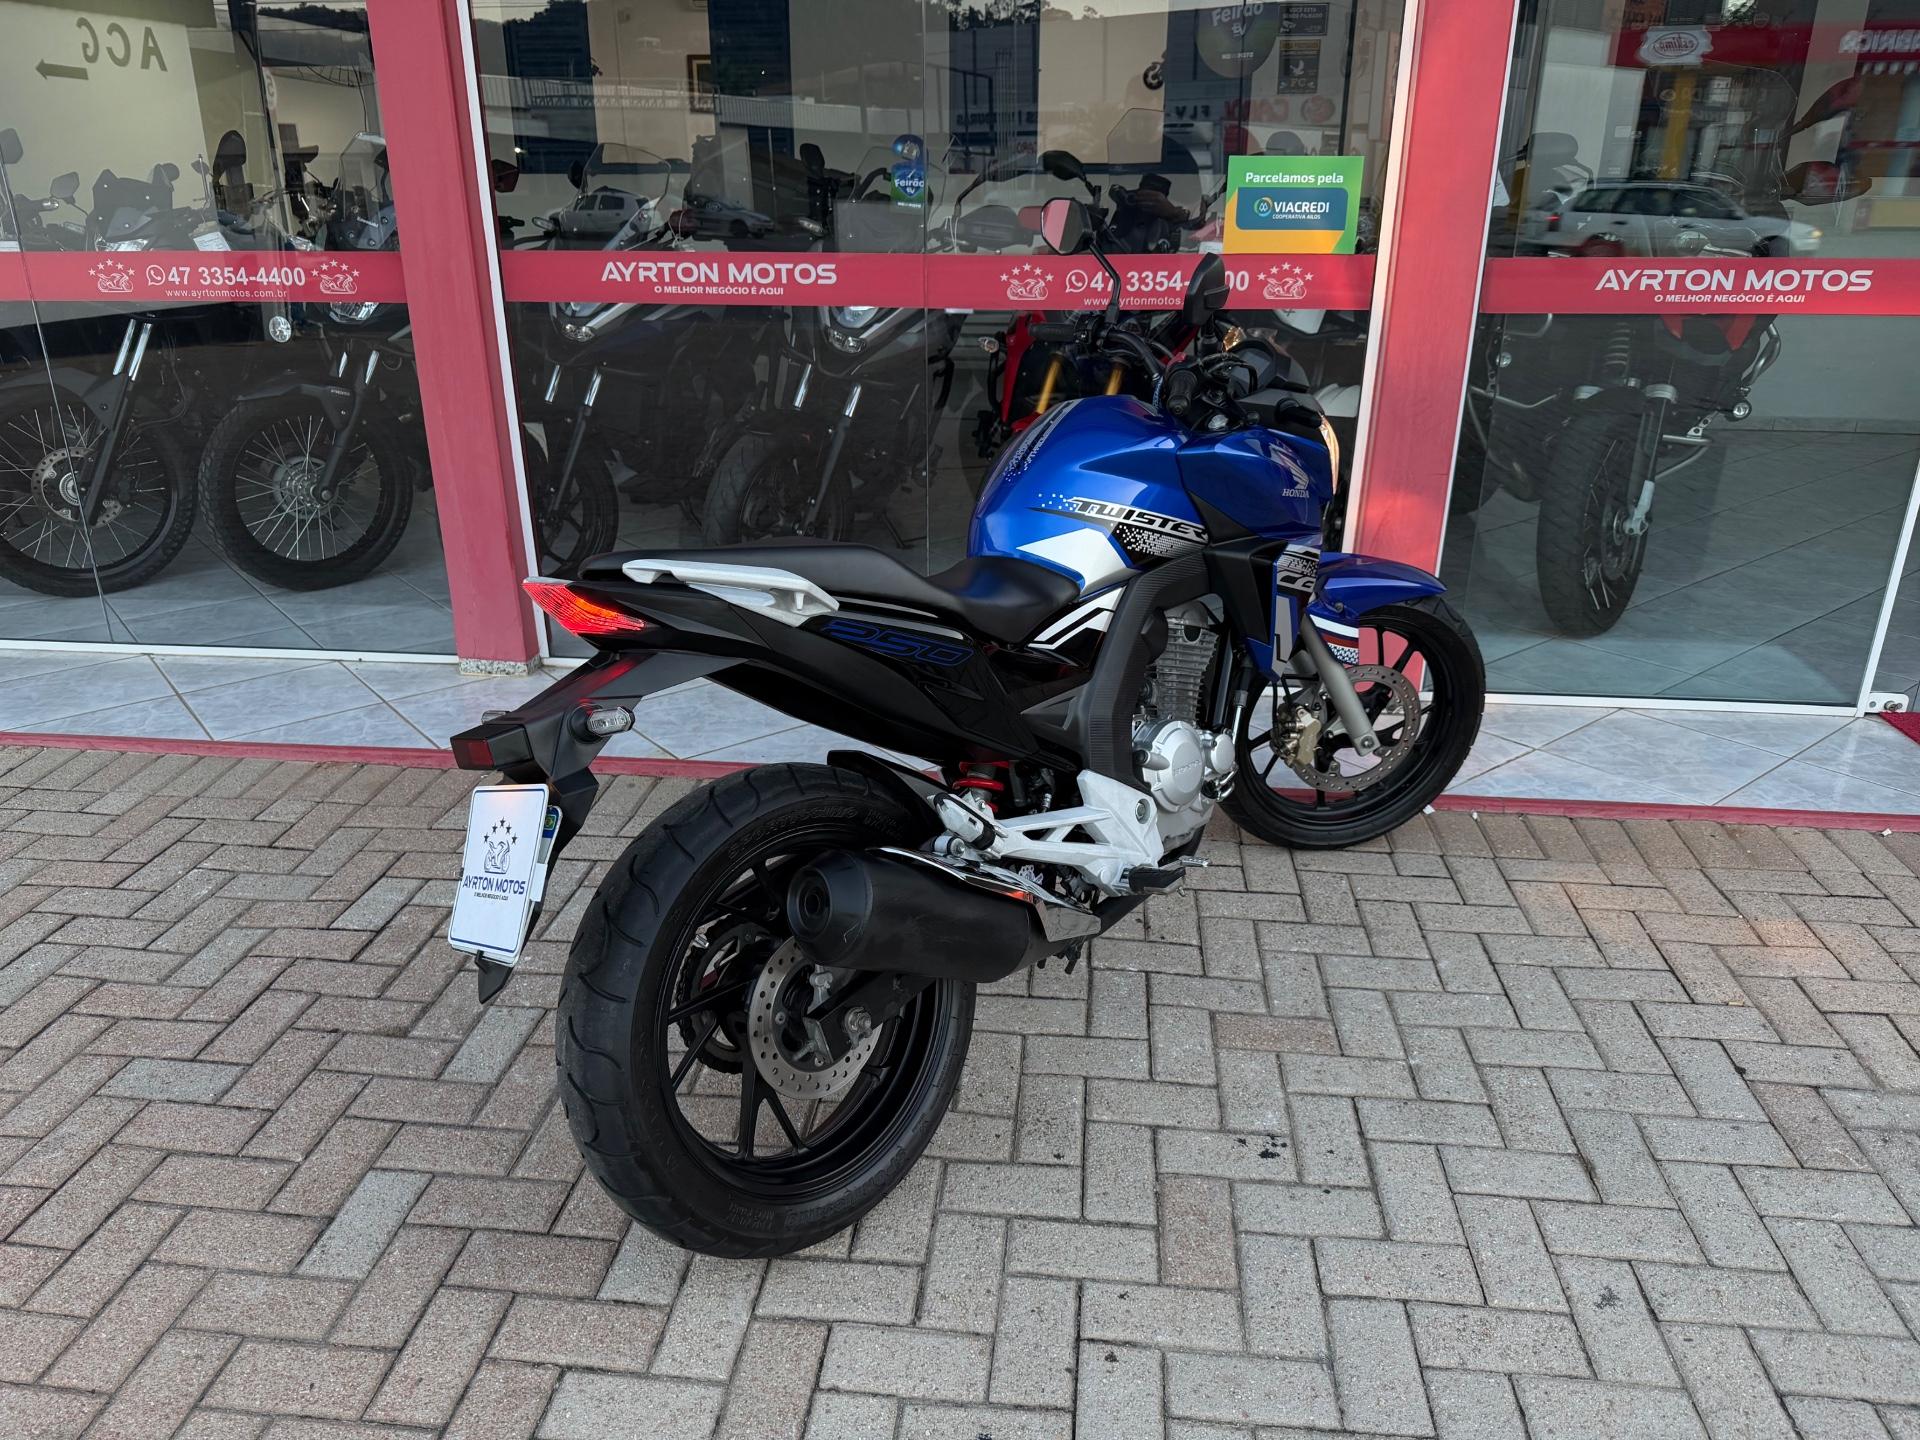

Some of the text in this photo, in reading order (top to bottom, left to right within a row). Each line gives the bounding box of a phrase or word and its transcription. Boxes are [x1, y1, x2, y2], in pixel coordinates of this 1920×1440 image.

[1245, 172, 1344, 186] Parcelamos pela
[1273, 201, 1330, 213] VIACREDI
[168, 266, 306, 286] 47 3354-4400
[601, 261, 837, 285] AYRTON MOTOS
[1126, 270, 1249, 292] 3354-00
[1595, 269, 1874, 292] AYRTON MOTOS
[165, 289, 288, 298] www.ayrtonmotos.com.br
[664, 286, 704, 294] MELHOR
[705, 285, 750, 295] NEGÓCIO
[759, 287, 784, 295] AQUI
[1654, 294, 1663, 303] O
[1665, 294, 1712, 302] MELHOR
[1713, 293, 1765, 303] NEGÓCIO
[1775, 294, 1806, 303] AQUI
[1282, 488, 1310, 498] HONDA
[821, 617, 974, 667] 250
[463, 874, 526, 895] AYRTON MOTOS
